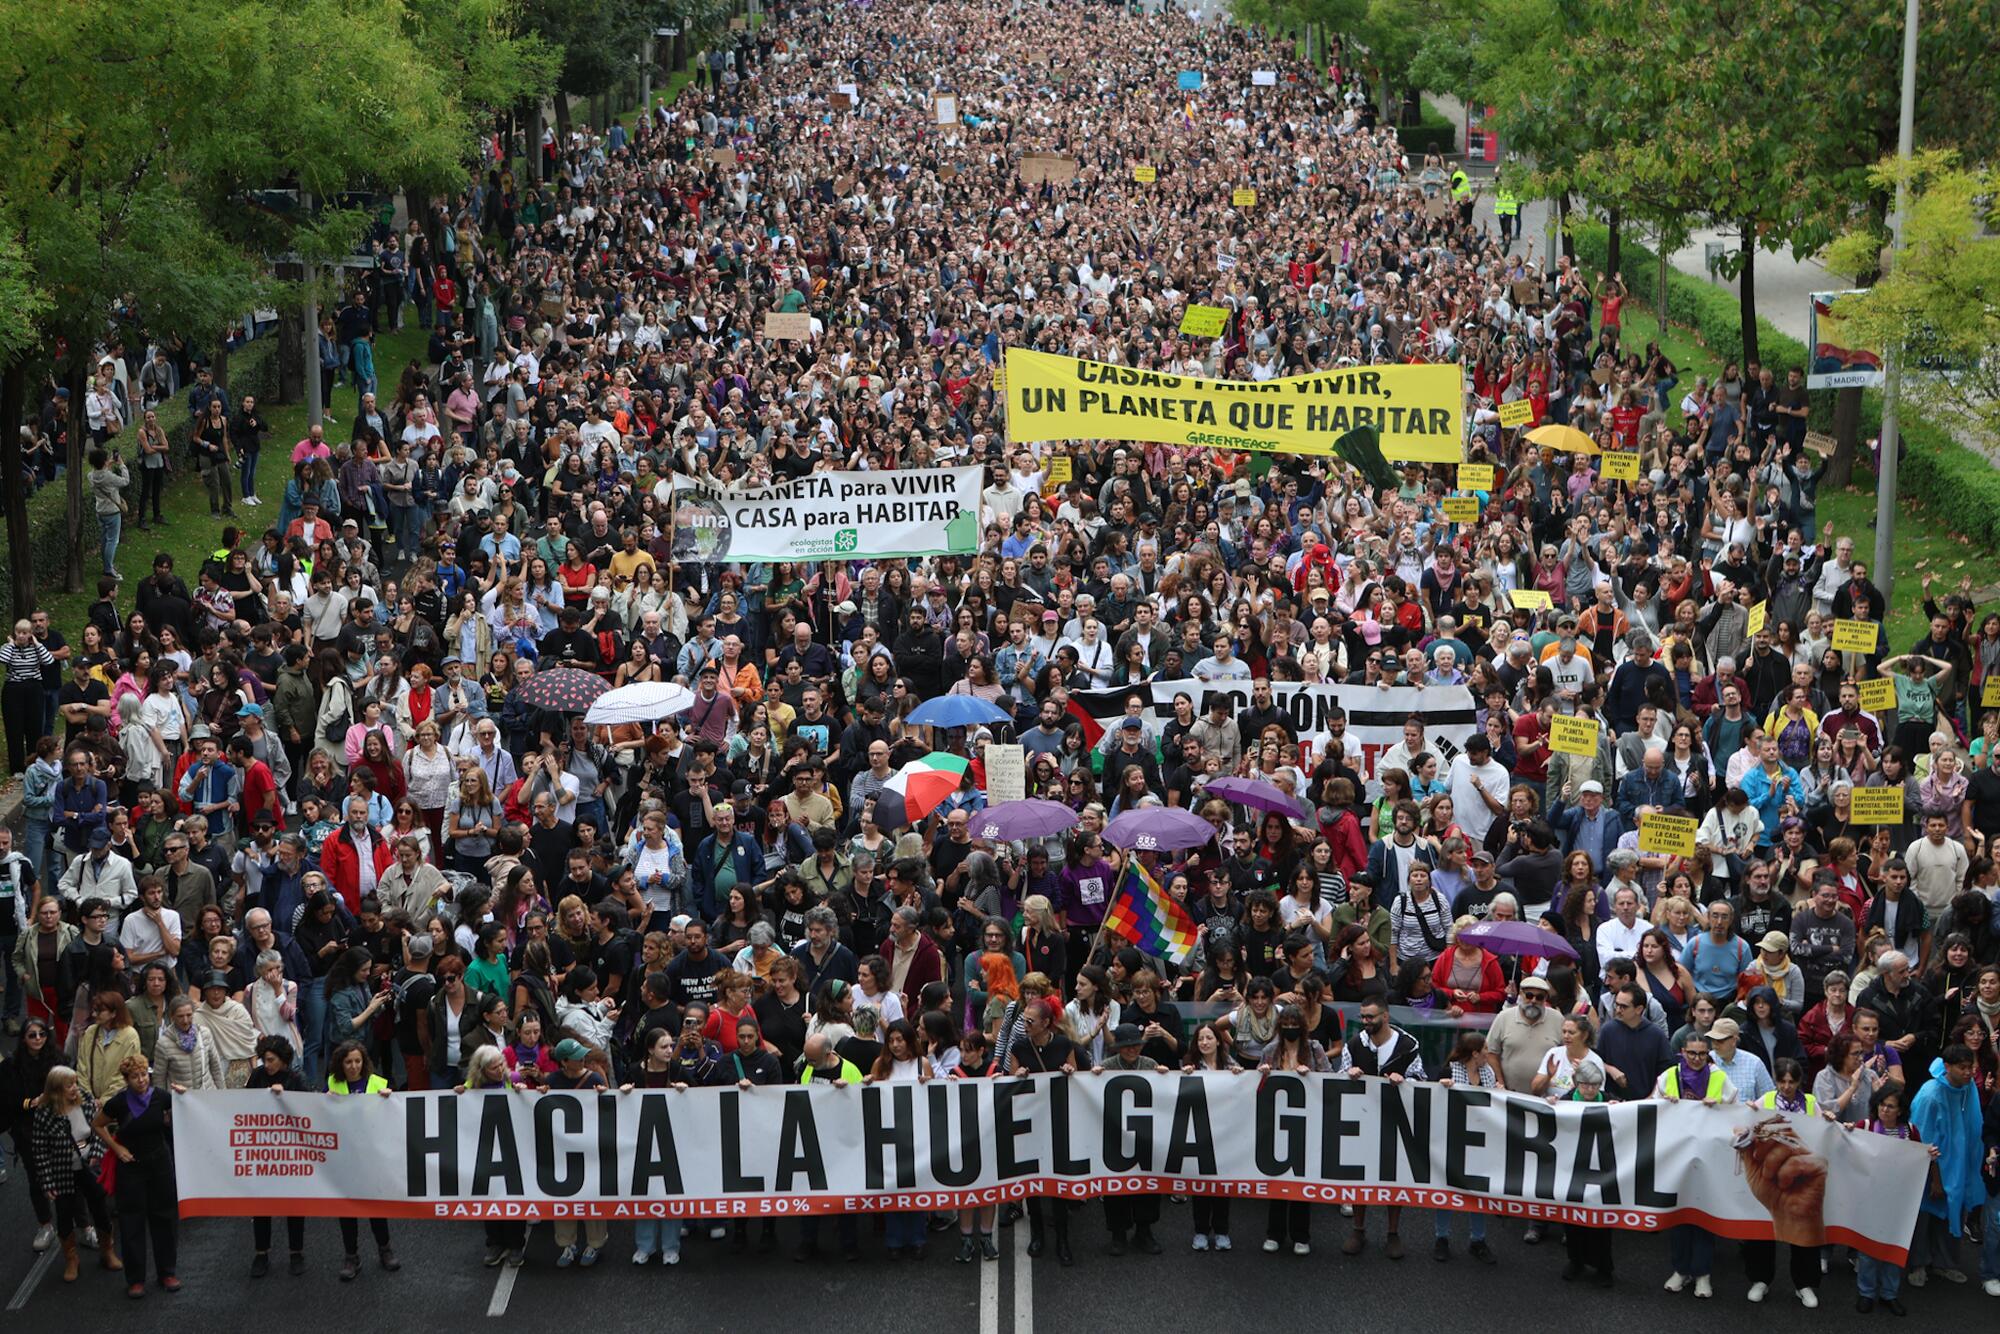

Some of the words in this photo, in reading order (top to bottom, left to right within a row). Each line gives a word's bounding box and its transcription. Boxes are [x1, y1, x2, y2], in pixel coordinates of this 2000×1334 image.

[1834, 376, 1865, 385] MADRID
[1022, 387, 1066, 413] UN
[1079, 389, 1217, 426] PLANETA
[1229, 402, 1294, 432] QUE
[1307, 404, 1451, 435] HABITAR
[1186, 431, 1280, 450] GREENPEACE
[840, 479, 886, 501] para
[891, 474, 956, 495] VIVIR
[692, 514, 729, 528] una
[735, 507, 797, 528] CASA
[804, 508, 850, 530] para
[856, 500, 960, 524] HABITAR
[790, 538, 833, 548] ecologistas
[806, 545, 833, 553] acción
[1200, 685, 1339, 732] ACIÓN
[1642, 822, 1670, 830] NUESTRO
[1650, 815, 1690, 826] DEFENDAMOS
[1664, 832, 1680, 840] CASA
[1664, 840, 1685, 848] TIERRA
[681, 978, 698, 986] NEW
[233, 1113, 311, 1129] SINDICATO
[234, 1131, 253, 1145] DE
[255, 1131, 335, 1148] INQUILINAS
[405, 1093, 685, 1198] HACIA
[719, 1090, 829, 1194] LA
[861, 1074, 1218, 1190] HUELGA
[1255, 1075, 1679, 1208] GENERAL
[234, 1149, 243, 1161] E
[245, 1149, 327, 1163] INQUILINOS
[234, 1164, 253, 1177] DE
[255, 1163, 314, 1177] MADRID
[434, 1202, 541, 1217] BAJADA
[553, 1202, 602, 1217] DEL
[613, 1200, 748, 1218] ALQUILER
[759, 1198, 811, 1213] 50%
[843, 1179, 1044, 1211] EXPROPIACIÓN
[1058, 1177, 1159, 1198] FONDOS
[1172, 1178, 1268, 1196] BUITRE
[1302, 1185, 1465, 1207] CONTRATOS
[1477, 1197, 1659, 1228] INDEFINIDOS
